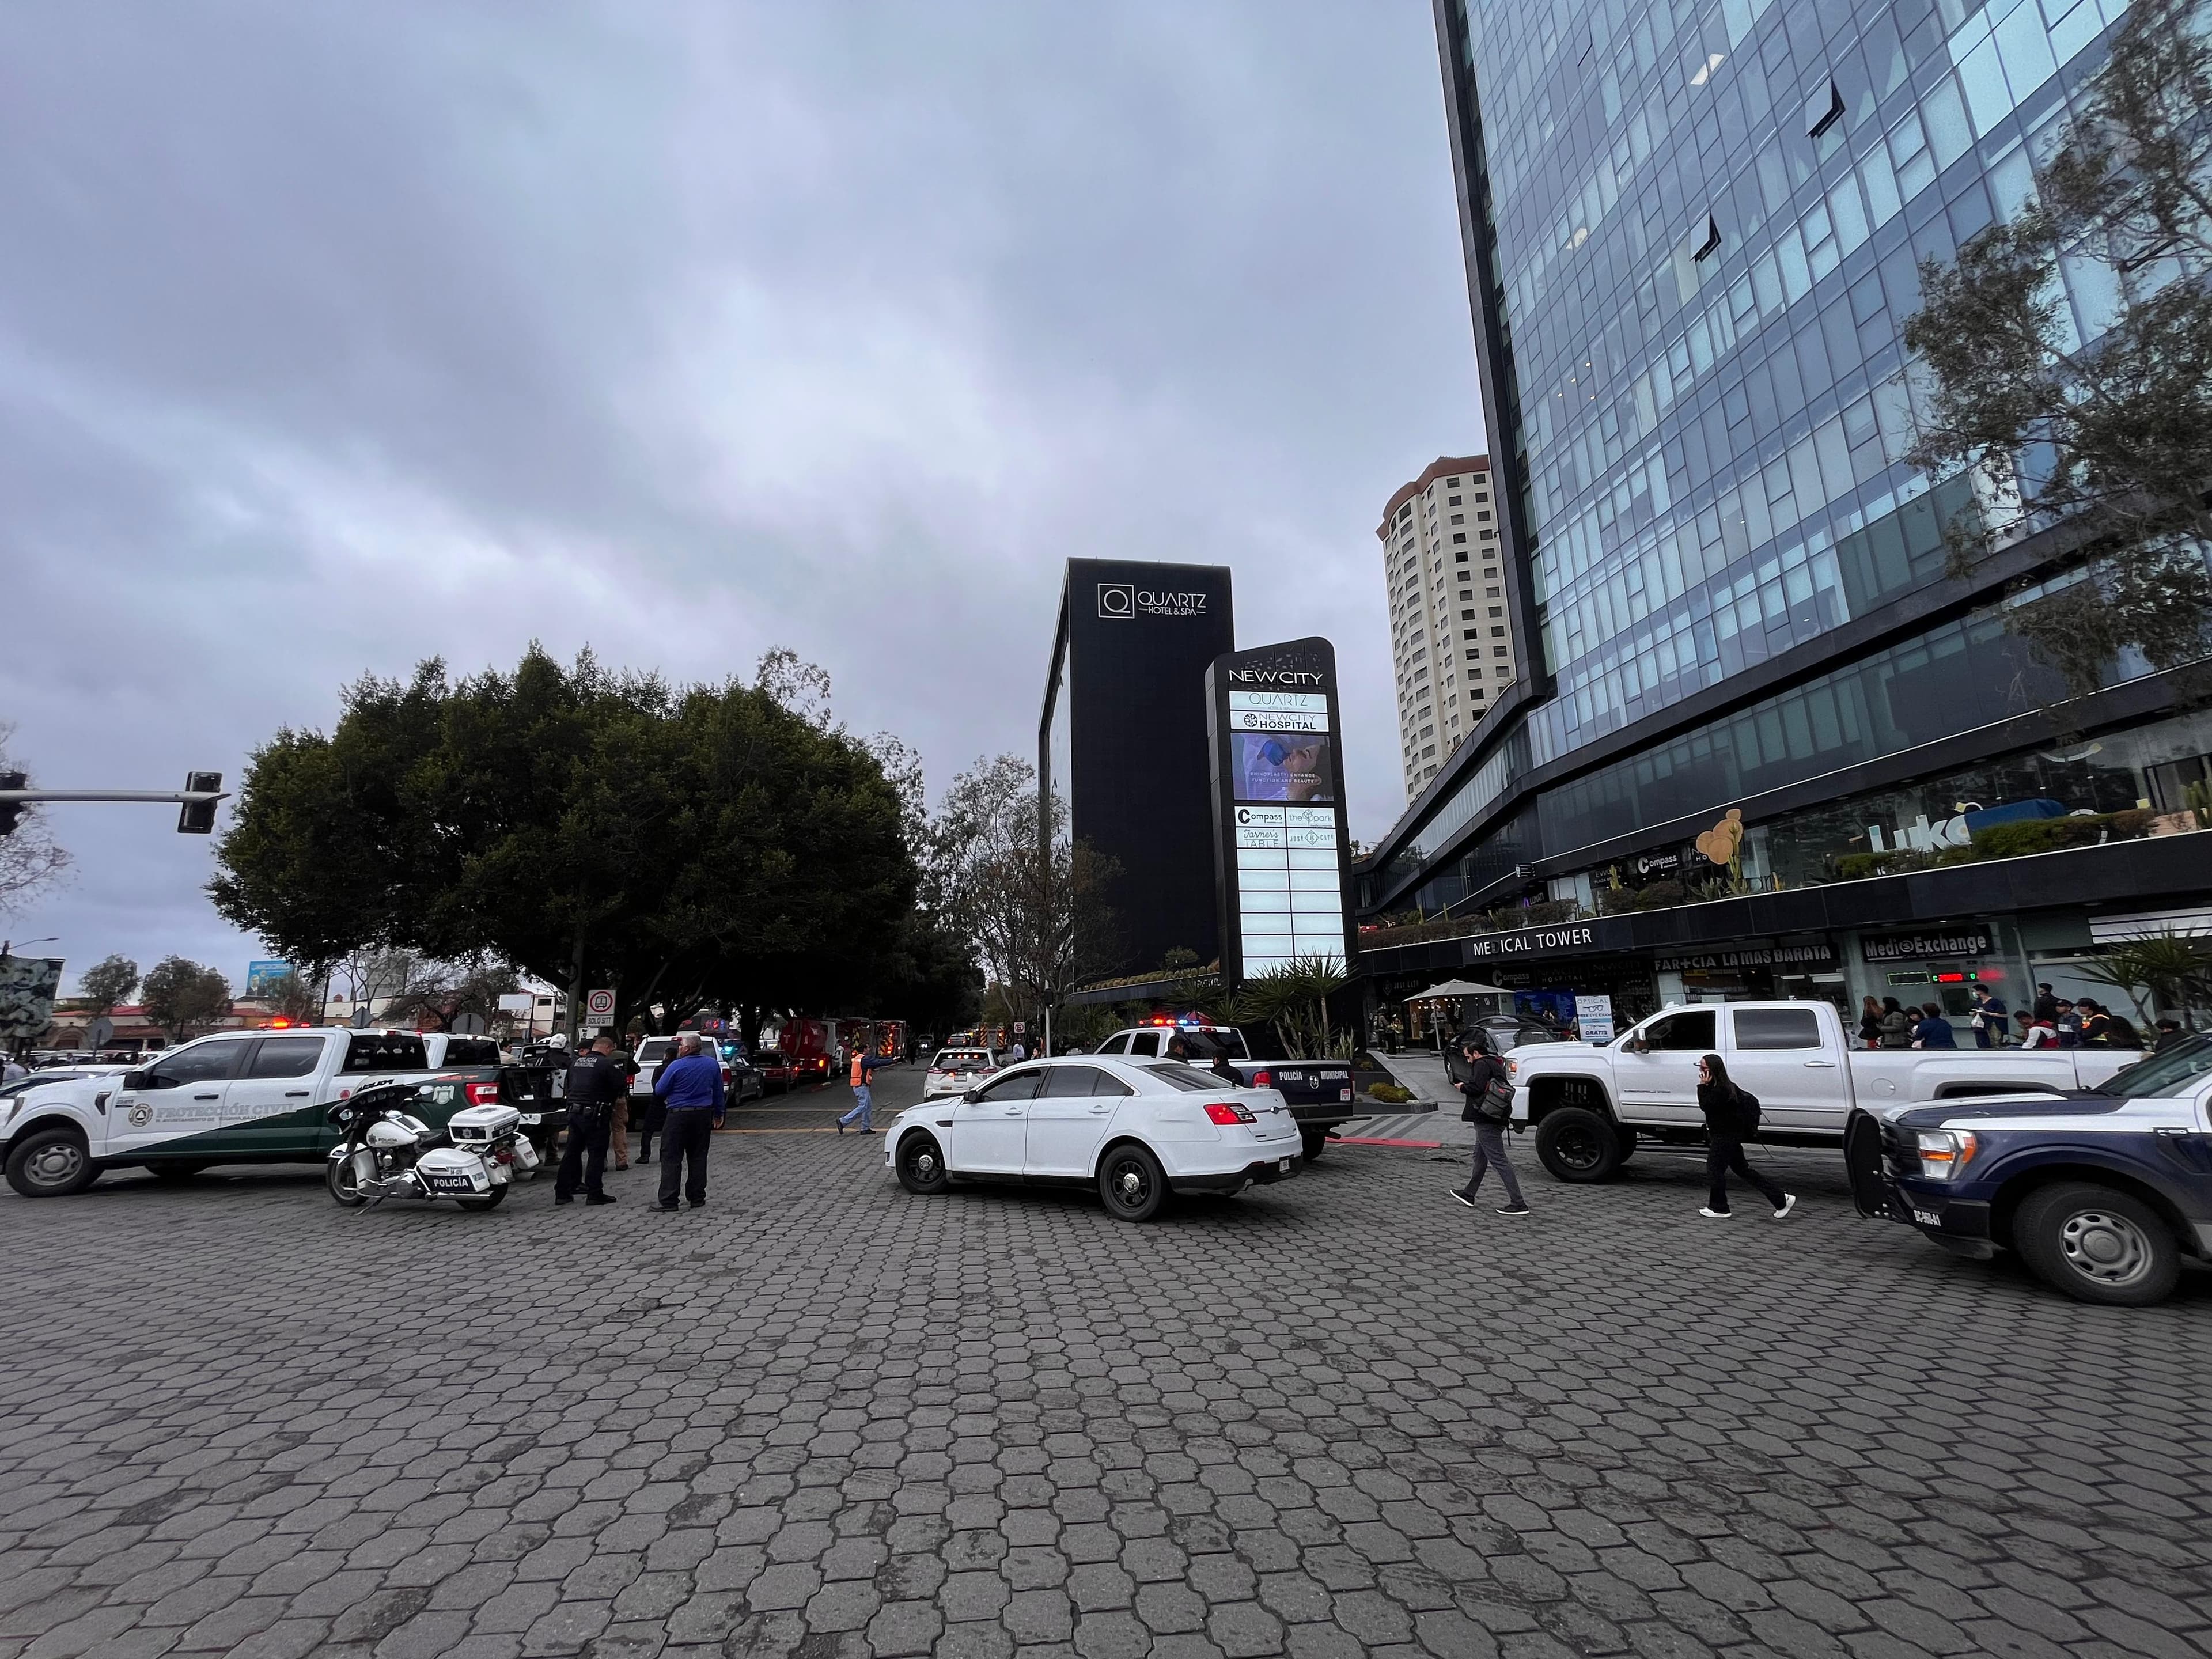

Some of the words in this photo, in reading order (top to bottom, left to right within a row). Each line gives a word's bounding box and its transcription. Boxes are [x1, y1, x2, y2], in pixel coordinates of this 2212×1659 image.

[1138, 591, 1207, 608] QUARTZ
[1148, 606, 1173, 615] HOTEL
[1173, 607, 1180, 615] &
[1180, 608, 1197, 616] SPA
[1249, 692, 1308, 707] QUARTZ
[1259, 713, 1316, 721] NEWCITY
[1260, 721, 1317, 730] HOSPITAL
[1238, 809, 1283, 824] Compass
[1313, 815, 1332, 823] park
[1243, 829, 1279, 838] Farmer's
[1244, 839, 1279, 847] TABLE
[1638, 855, 1677, 874] Compass
[1473, 937, 1532, 956] MEDICAL
[1535, 928, 1592, 949] TOWER
[1722, 952, 1738, 967] LA
[1740, 949, 1772, 965] MAS
[1773, 945, 1832, 963] BARATA
[1491, 969, 1530, 986] Compass
[1279, 1070, 1303, 1081] POLICÍA
[1320, 1070, 1349, 1080] MUNICIPAL
[156, 1103, 251, 1118] PROTECCIÓN
[252, 1103, 296, 1115] CIVIL
[433, 1176, 469, 1188] POLICÍA
